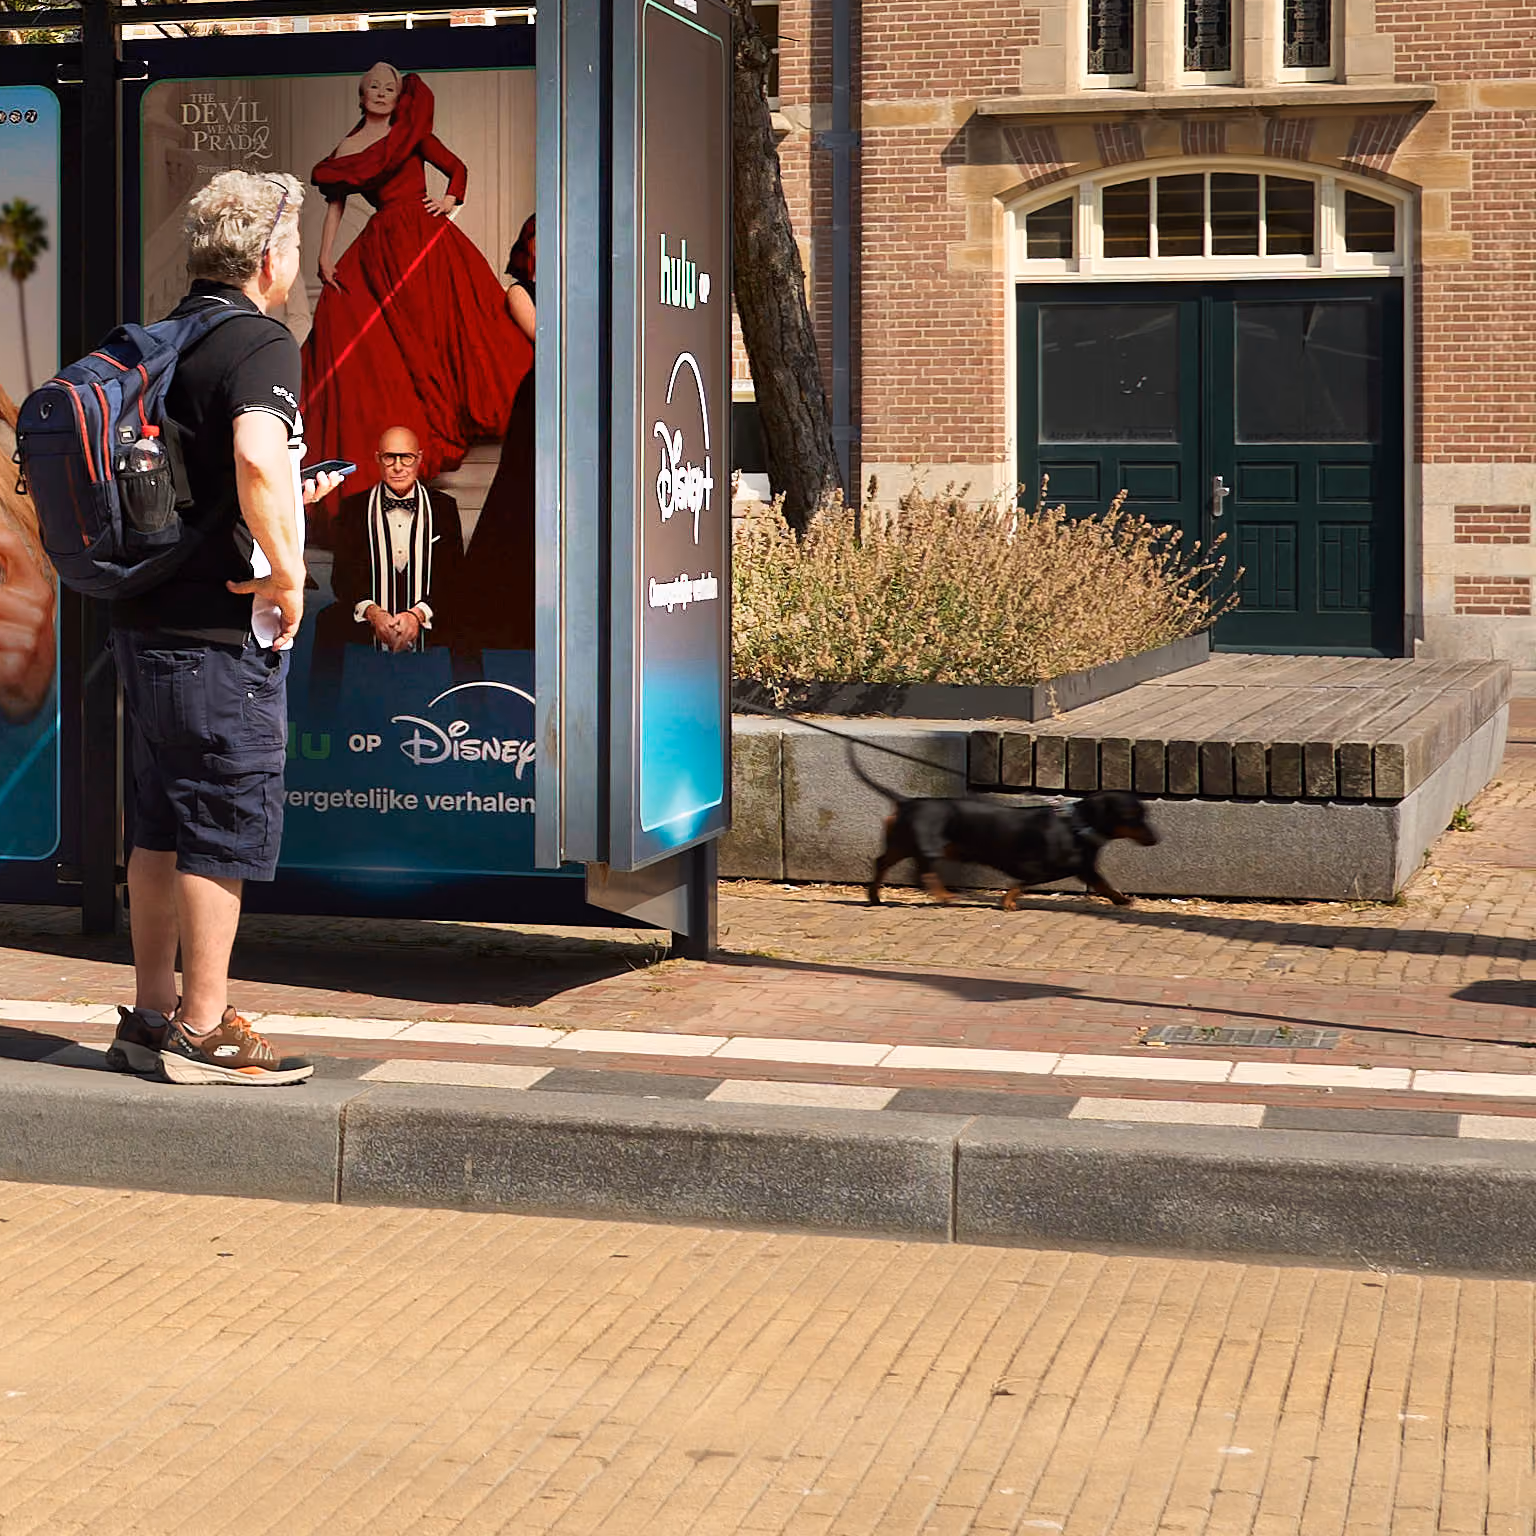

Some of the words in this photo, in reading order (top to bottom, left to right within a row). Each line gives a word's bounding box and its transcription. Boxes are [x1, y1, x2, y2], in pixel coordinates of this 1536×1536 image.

[180, 96, 268, 124] DEVIL
[190, 93, 216, 103] THE
[208, 124, 248, 134] WEARS
[659, 233, 696, 309] hulu
[286, 722, 331, 759] lu
[348, 734, 382, 752] OP
[391, 715, 535, 780] Disney
[425, 791, 535, 814] verhalen
